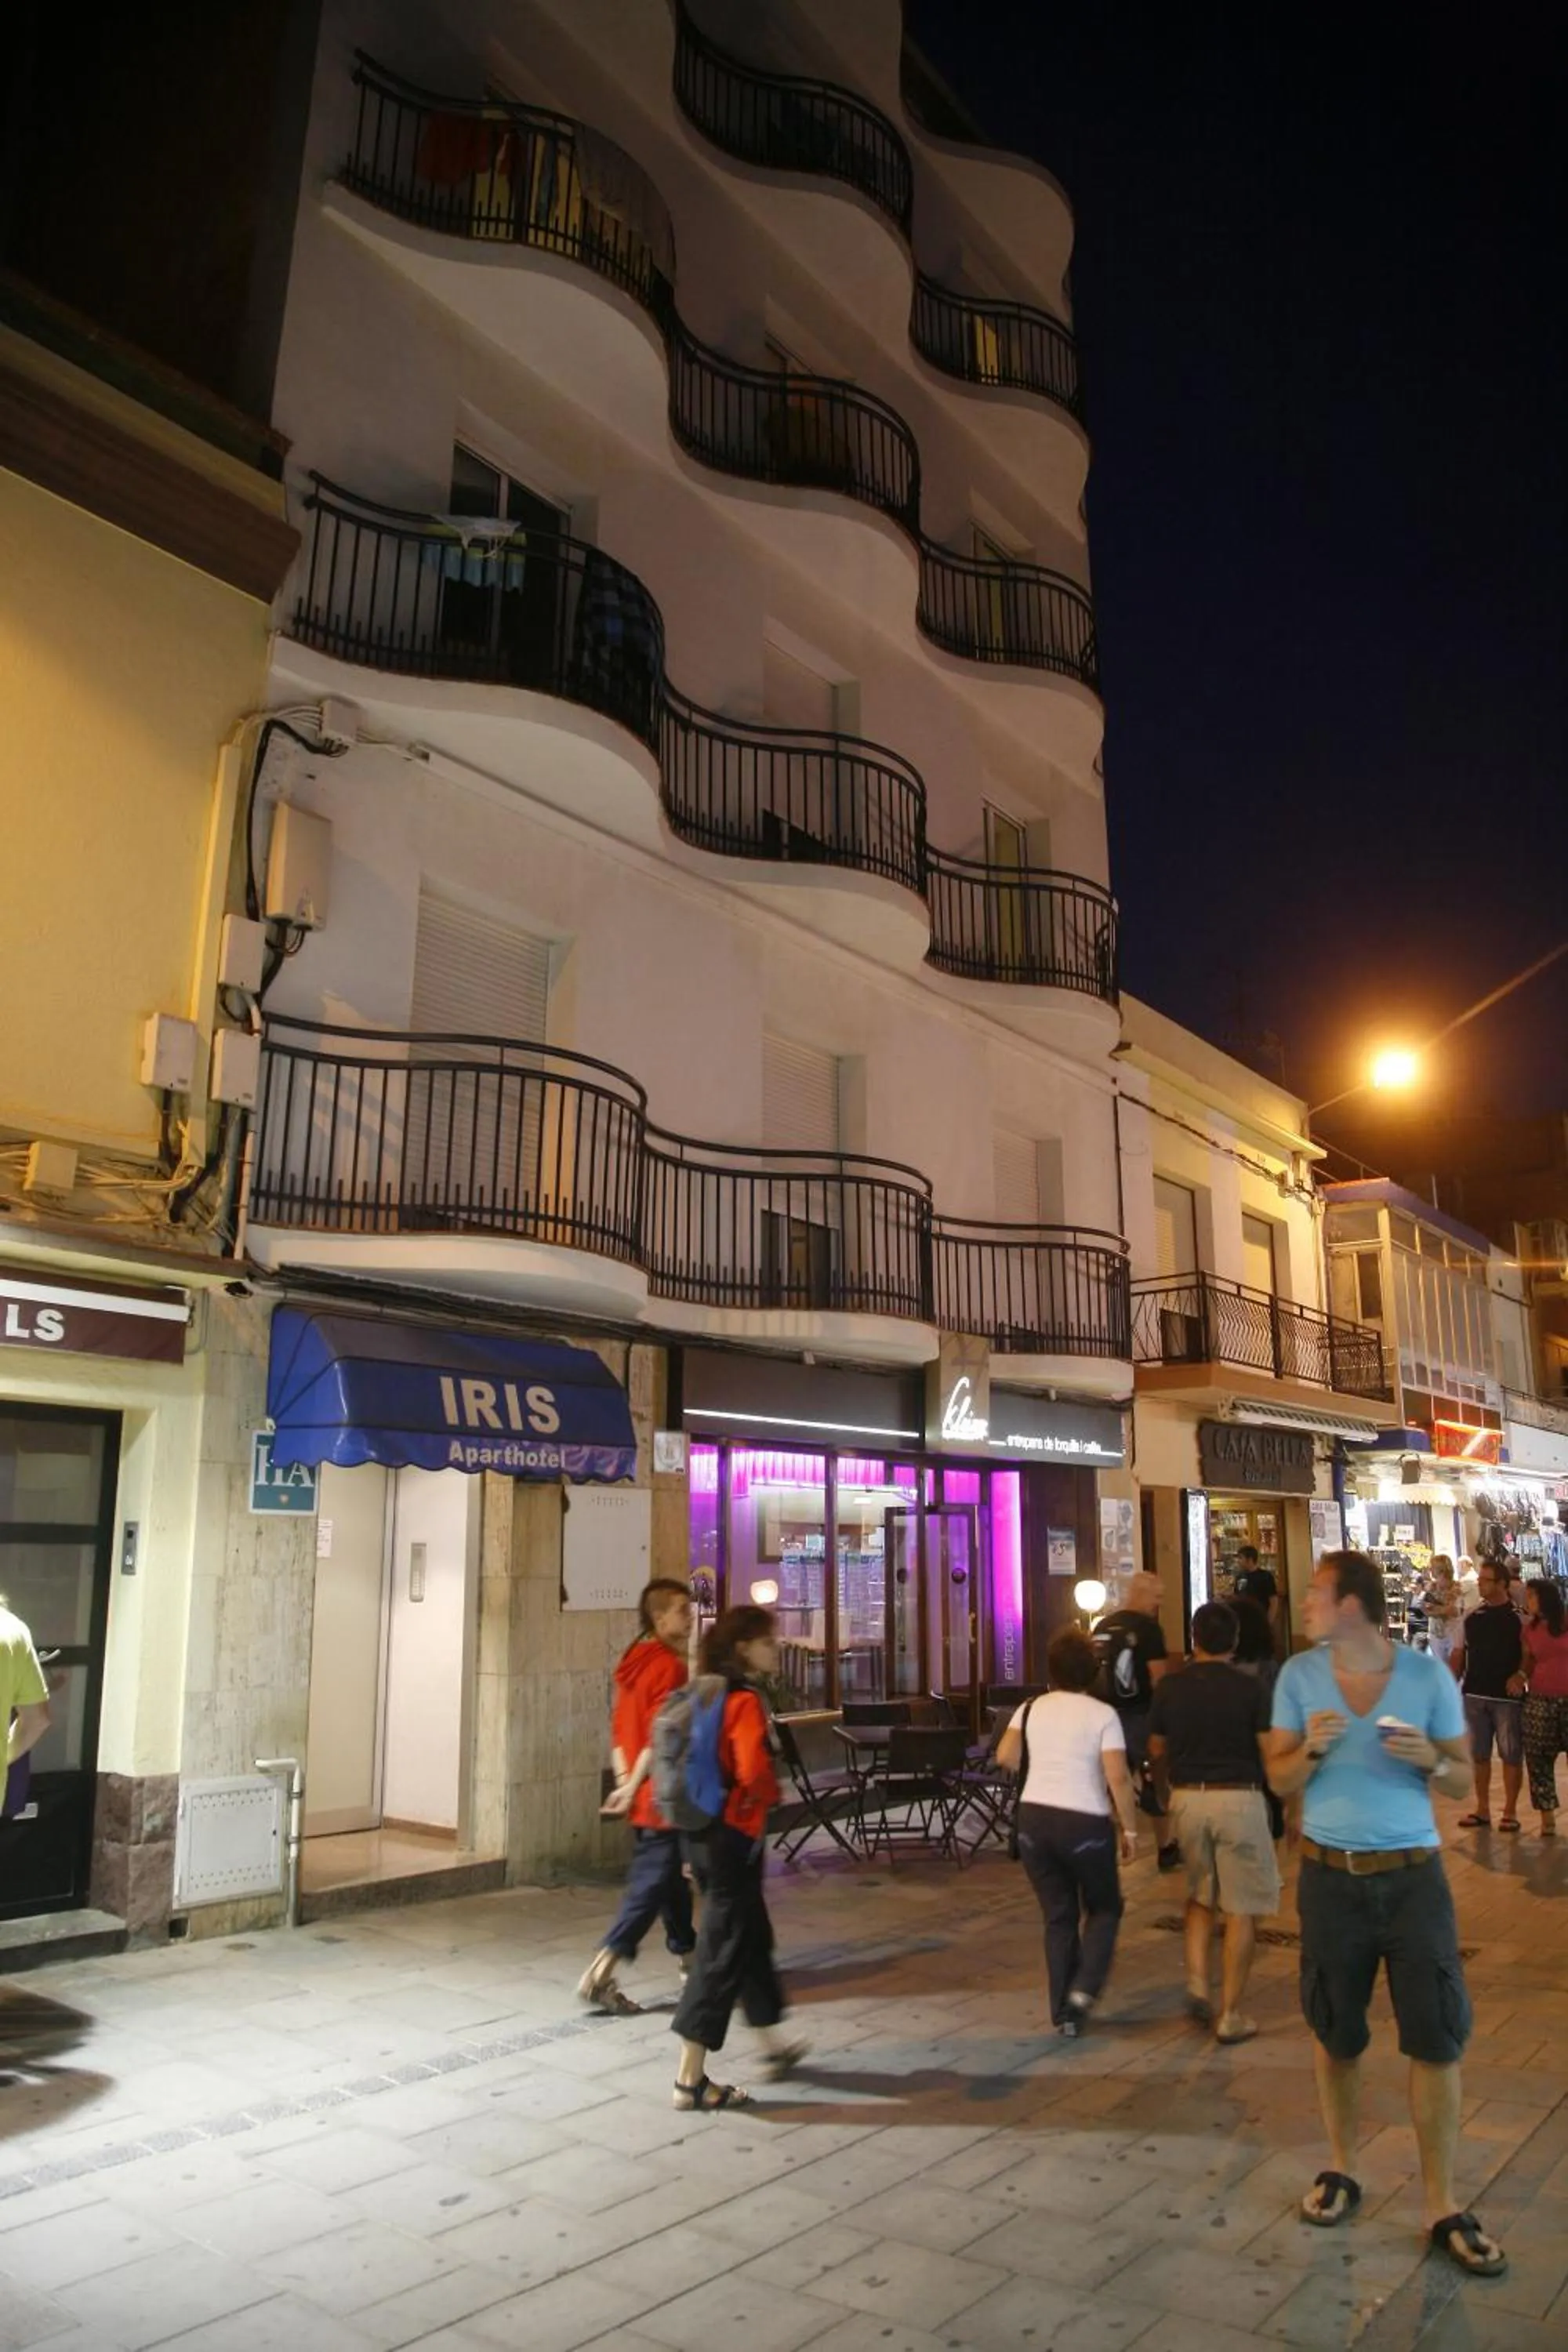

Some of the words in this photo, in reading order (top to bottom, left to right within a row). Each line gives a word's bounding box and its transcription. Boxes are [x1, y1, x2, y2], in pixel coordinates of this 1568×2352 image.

[440, 1376, 560, 1434] IRIS
[449, 1440, 566, 1468] Aparthotel
[1261, 1432, 1308, 1468] BELLA
